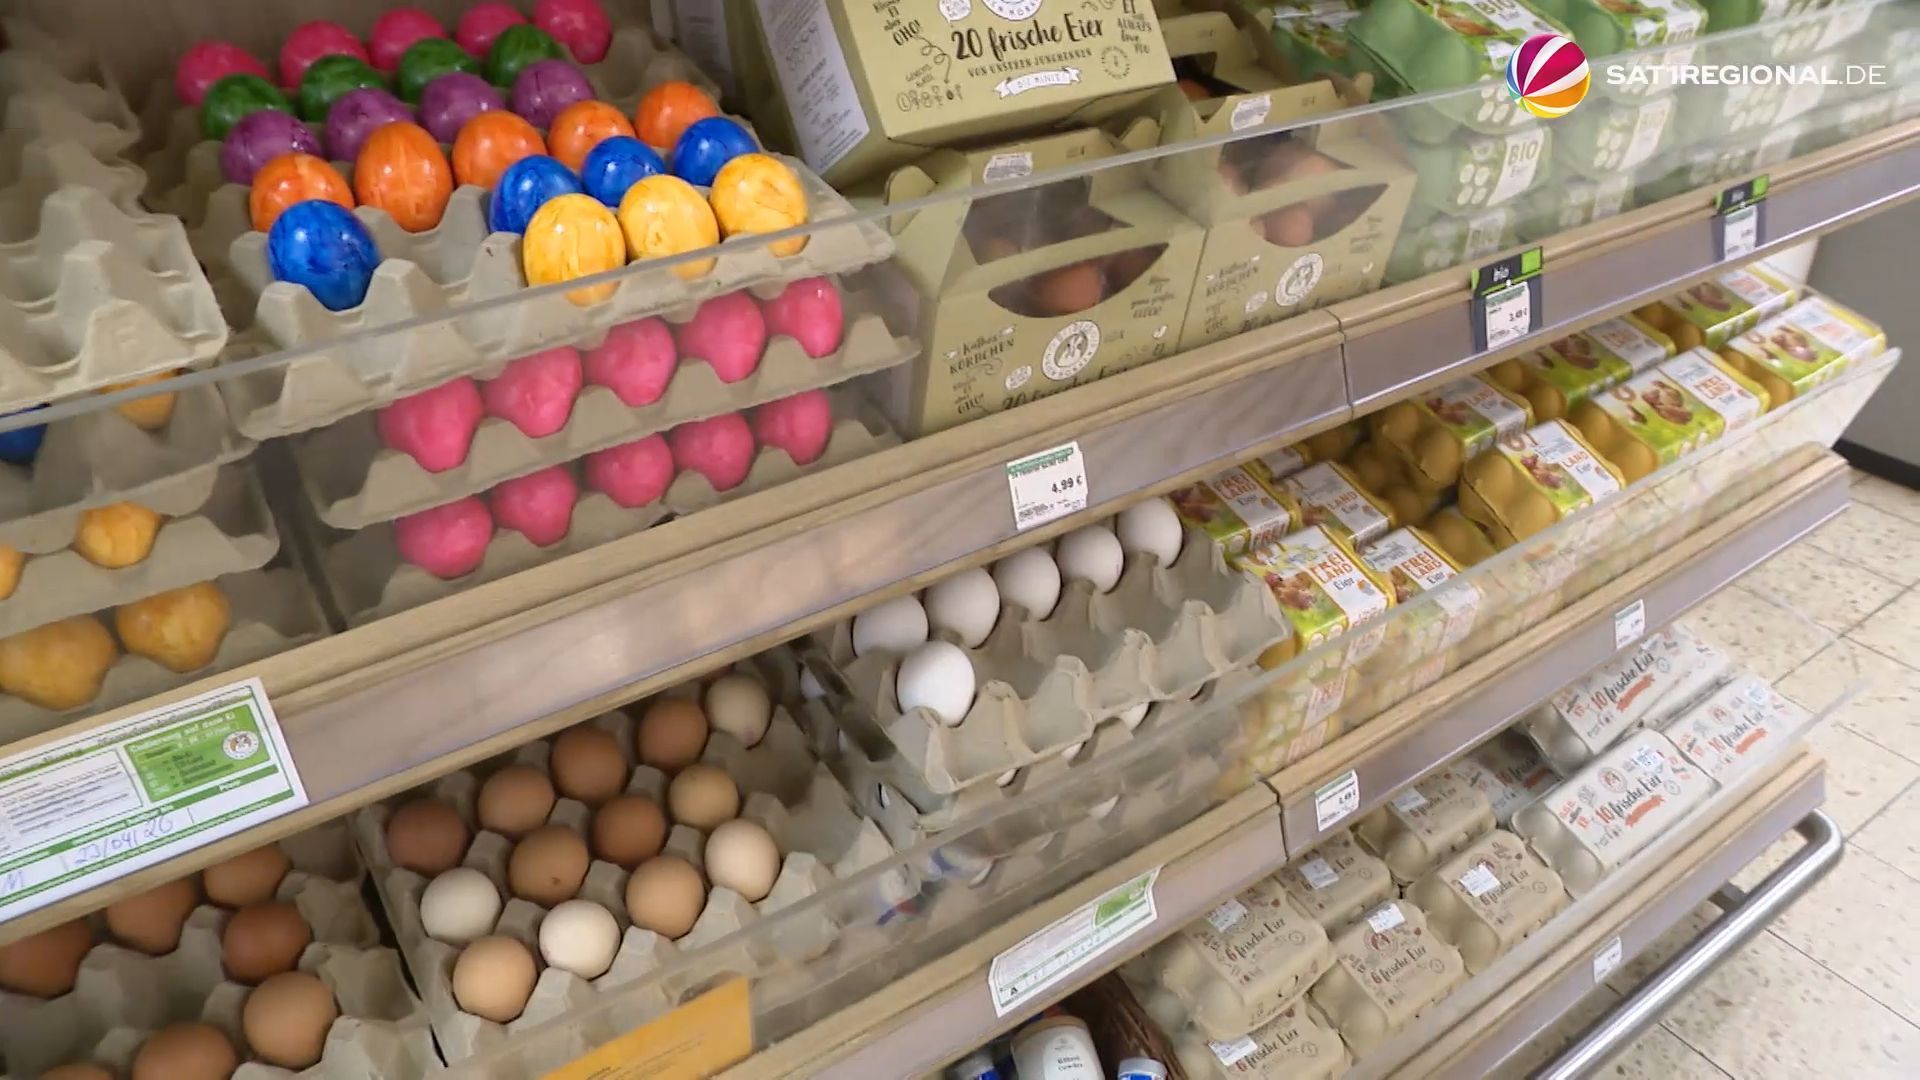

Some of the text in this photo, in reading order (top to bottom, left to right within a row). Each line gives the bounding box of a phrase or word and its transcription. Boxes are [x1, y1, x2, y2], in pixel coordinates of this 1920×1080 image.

[950, 12, 1103, 62] 20 frische Eier
[1508, 140, 1539, 167] BIO
[1310, 551, 1345, 575] FREI
[1317, 563, 1353, 584] LAND
[1401, 550, 1435, 571] FREI
[1408, 561, 1442, 580] LAND
[1590, 690, 1608, 711] 10
[1603, 668, 1638, 704] frische
[1595, 806, 1615, 824] 10
[1608, 787, 1644, 820] frische
[1234, 931, 1266, 959] frische
